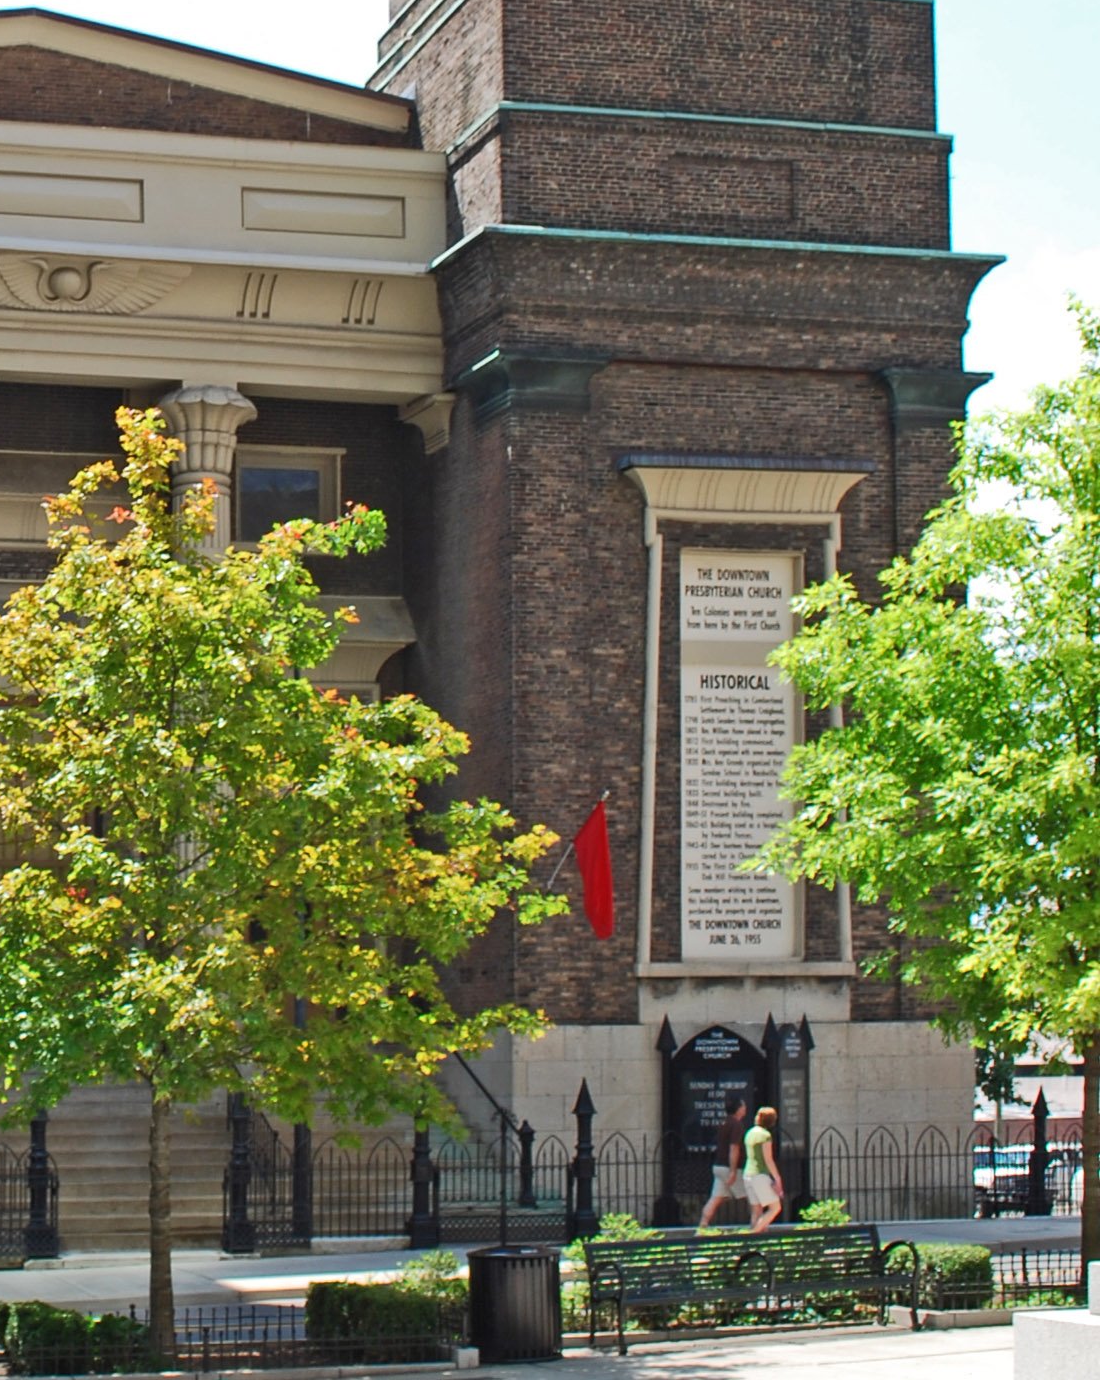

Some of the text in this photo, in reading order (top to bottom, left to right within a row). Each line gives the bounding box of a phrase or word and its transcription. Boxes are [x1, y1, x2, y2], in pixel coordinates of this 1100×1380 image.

[698, 568, 769, 582] THE DOWNTOWN
[685, 584, 782, 599] PRESBYTERIAN CHURCH
[732, 620, 740, 630] the
[744, 621, 757, 630] First
[760, 621, 780, 631] Church
[700, 674, 770, 690] HISTORICAL
[689, 920, 781, 930] THE DOWNTOWN CHURCH
[710, 934, 726, 945] JUNE
[745, 934, 761, 945] 1955
[702, 1052, 732, 1060] CHURCH
